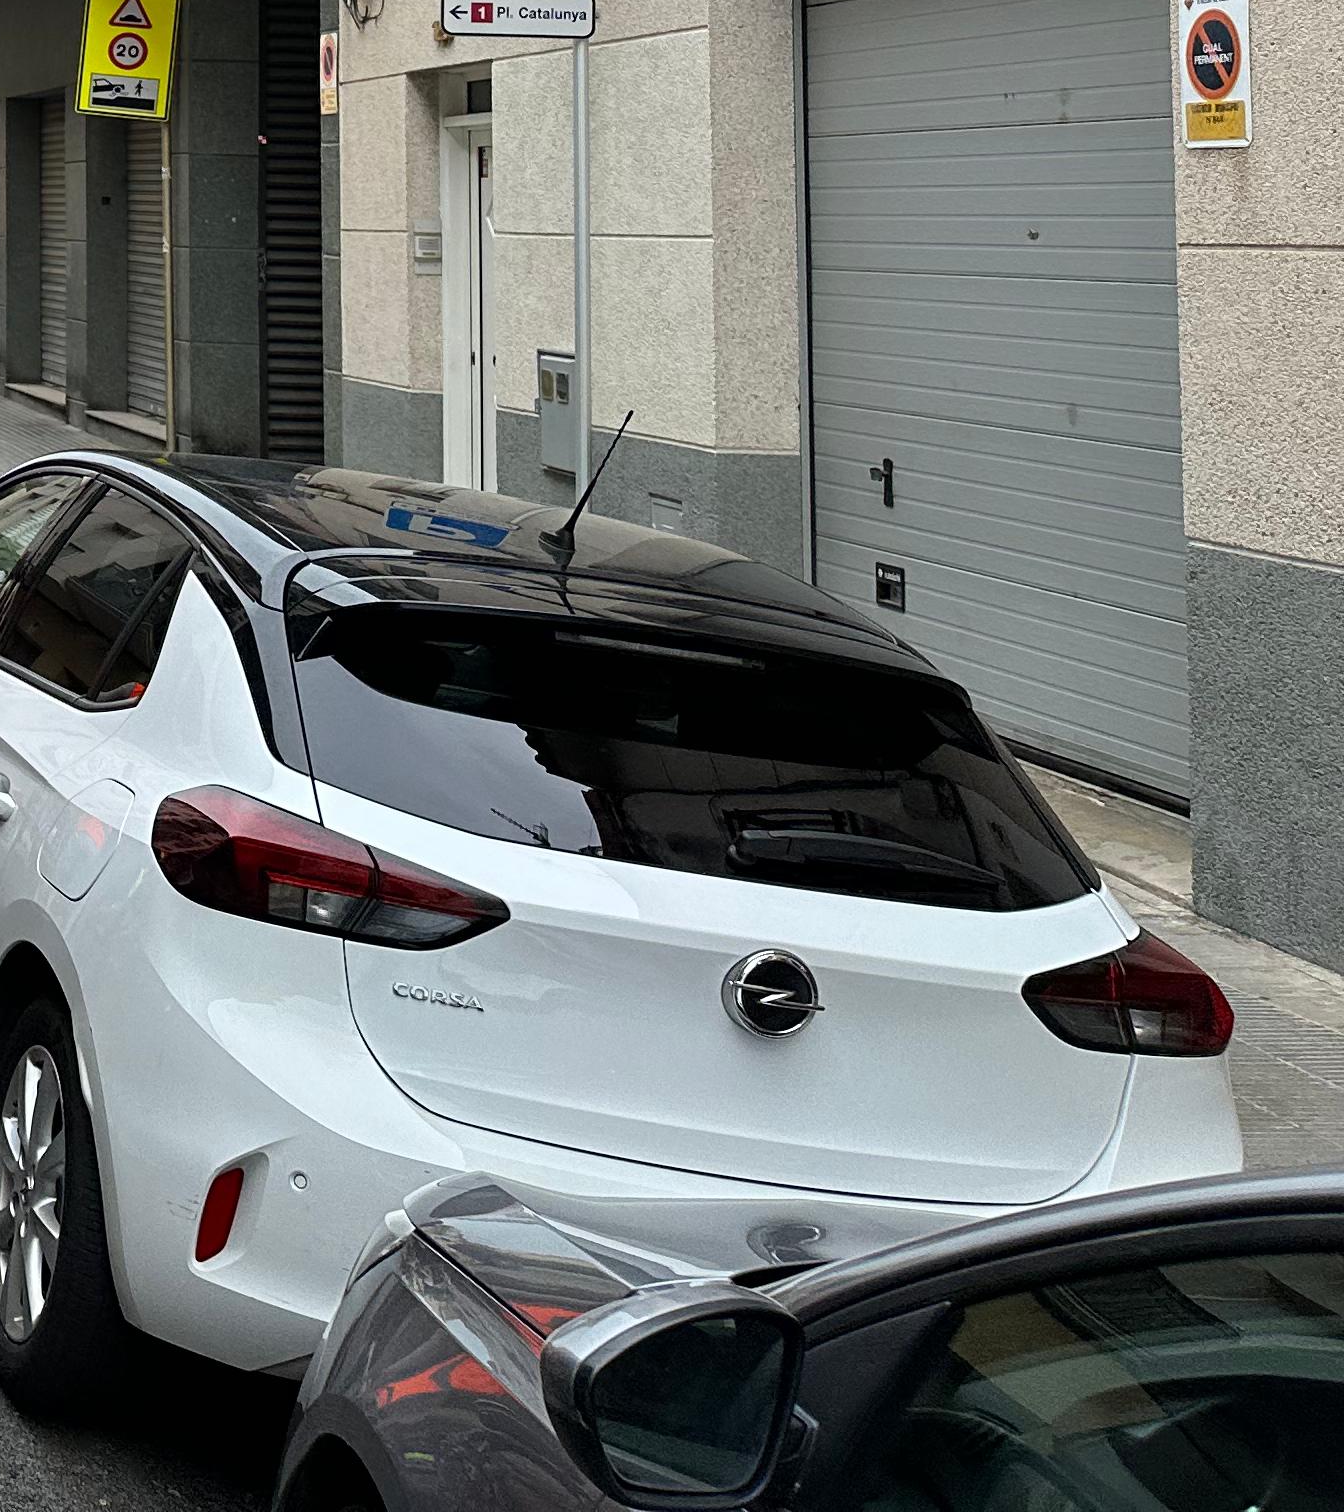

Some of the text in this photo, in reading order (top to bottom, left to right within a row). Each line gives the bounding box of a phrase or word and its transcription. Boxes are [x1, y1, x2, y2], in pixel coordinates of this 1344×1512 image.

[477, 5, 587, 23] 1 Pl. Catalunya
[116, 43, 140, 58] 20
[392, 981, 485, 1013] CORSA
